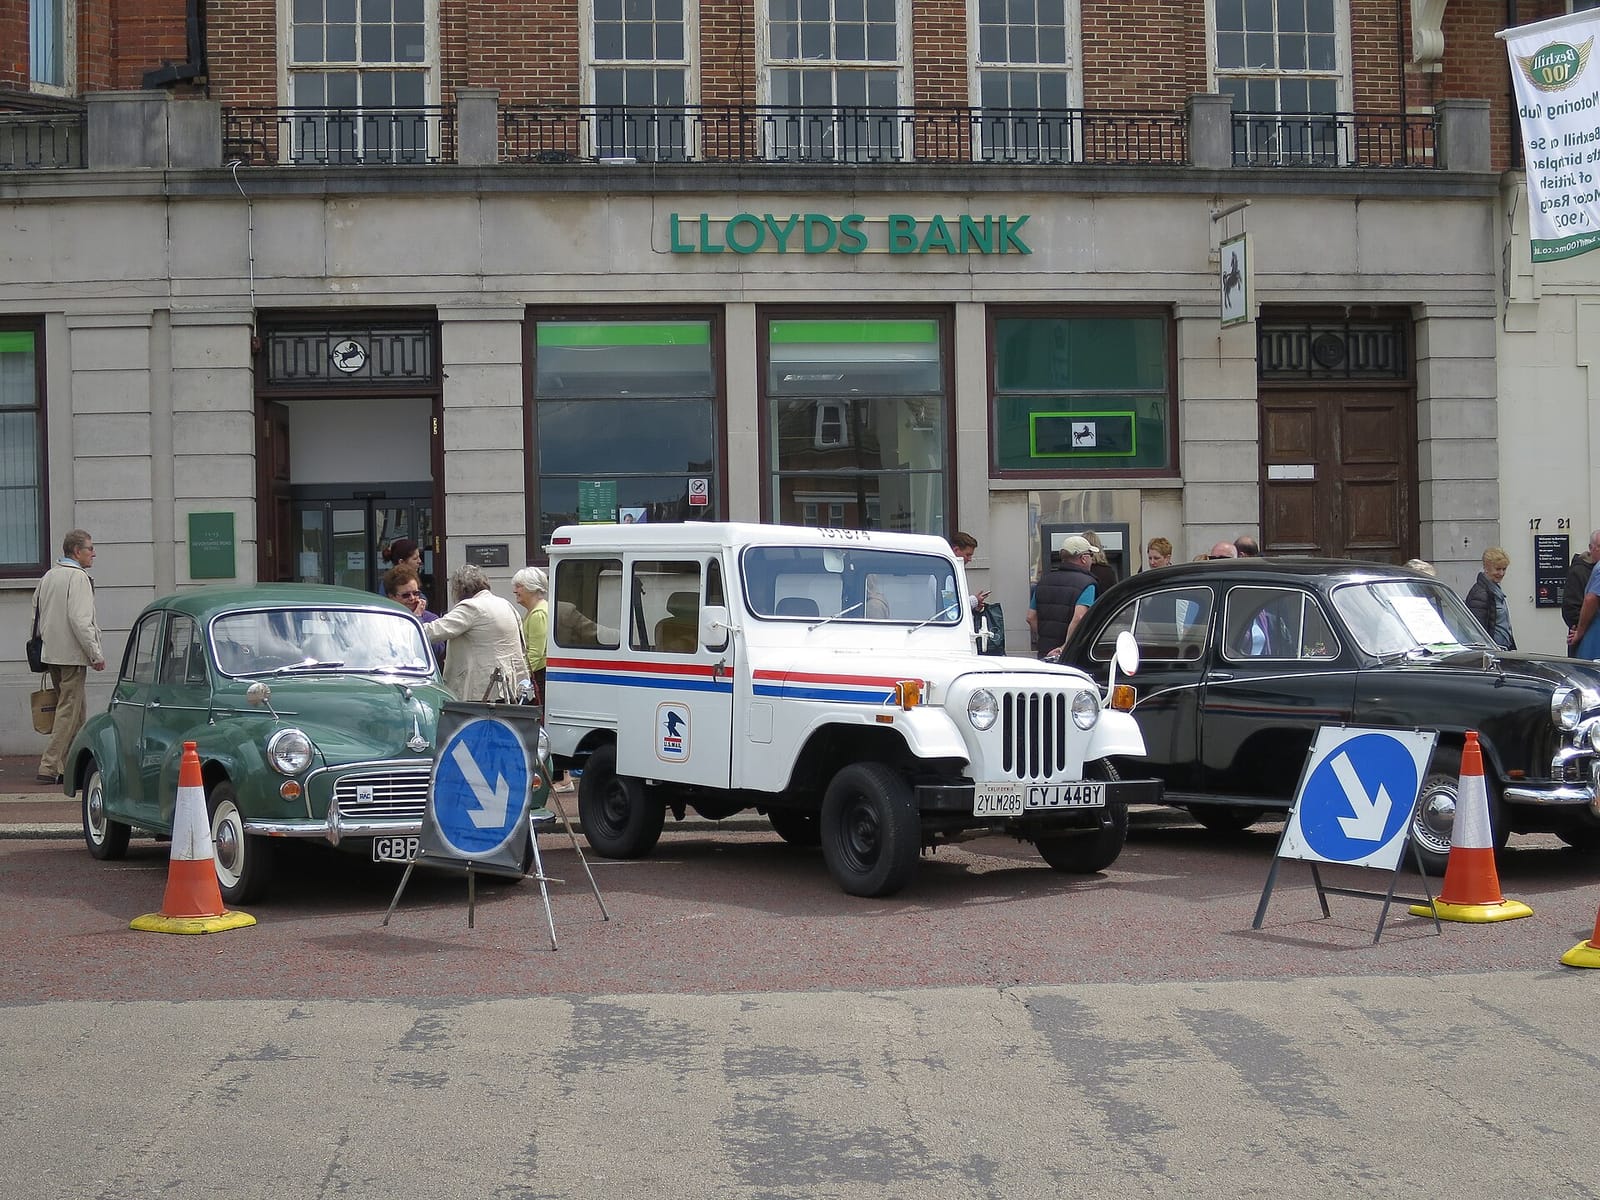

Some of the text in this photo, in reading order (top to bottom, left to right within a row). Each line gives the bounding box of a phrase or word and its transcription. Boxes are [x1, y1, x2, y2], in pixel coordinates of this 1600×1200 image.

[671, 213, 1032, 255] LLOYDS BANK
[1529, 518, 1571, 530] 17 21
[977, 794, 1021, 811] 2YLM285
[1029, 785, 1101, 806] CYJ 448Y
